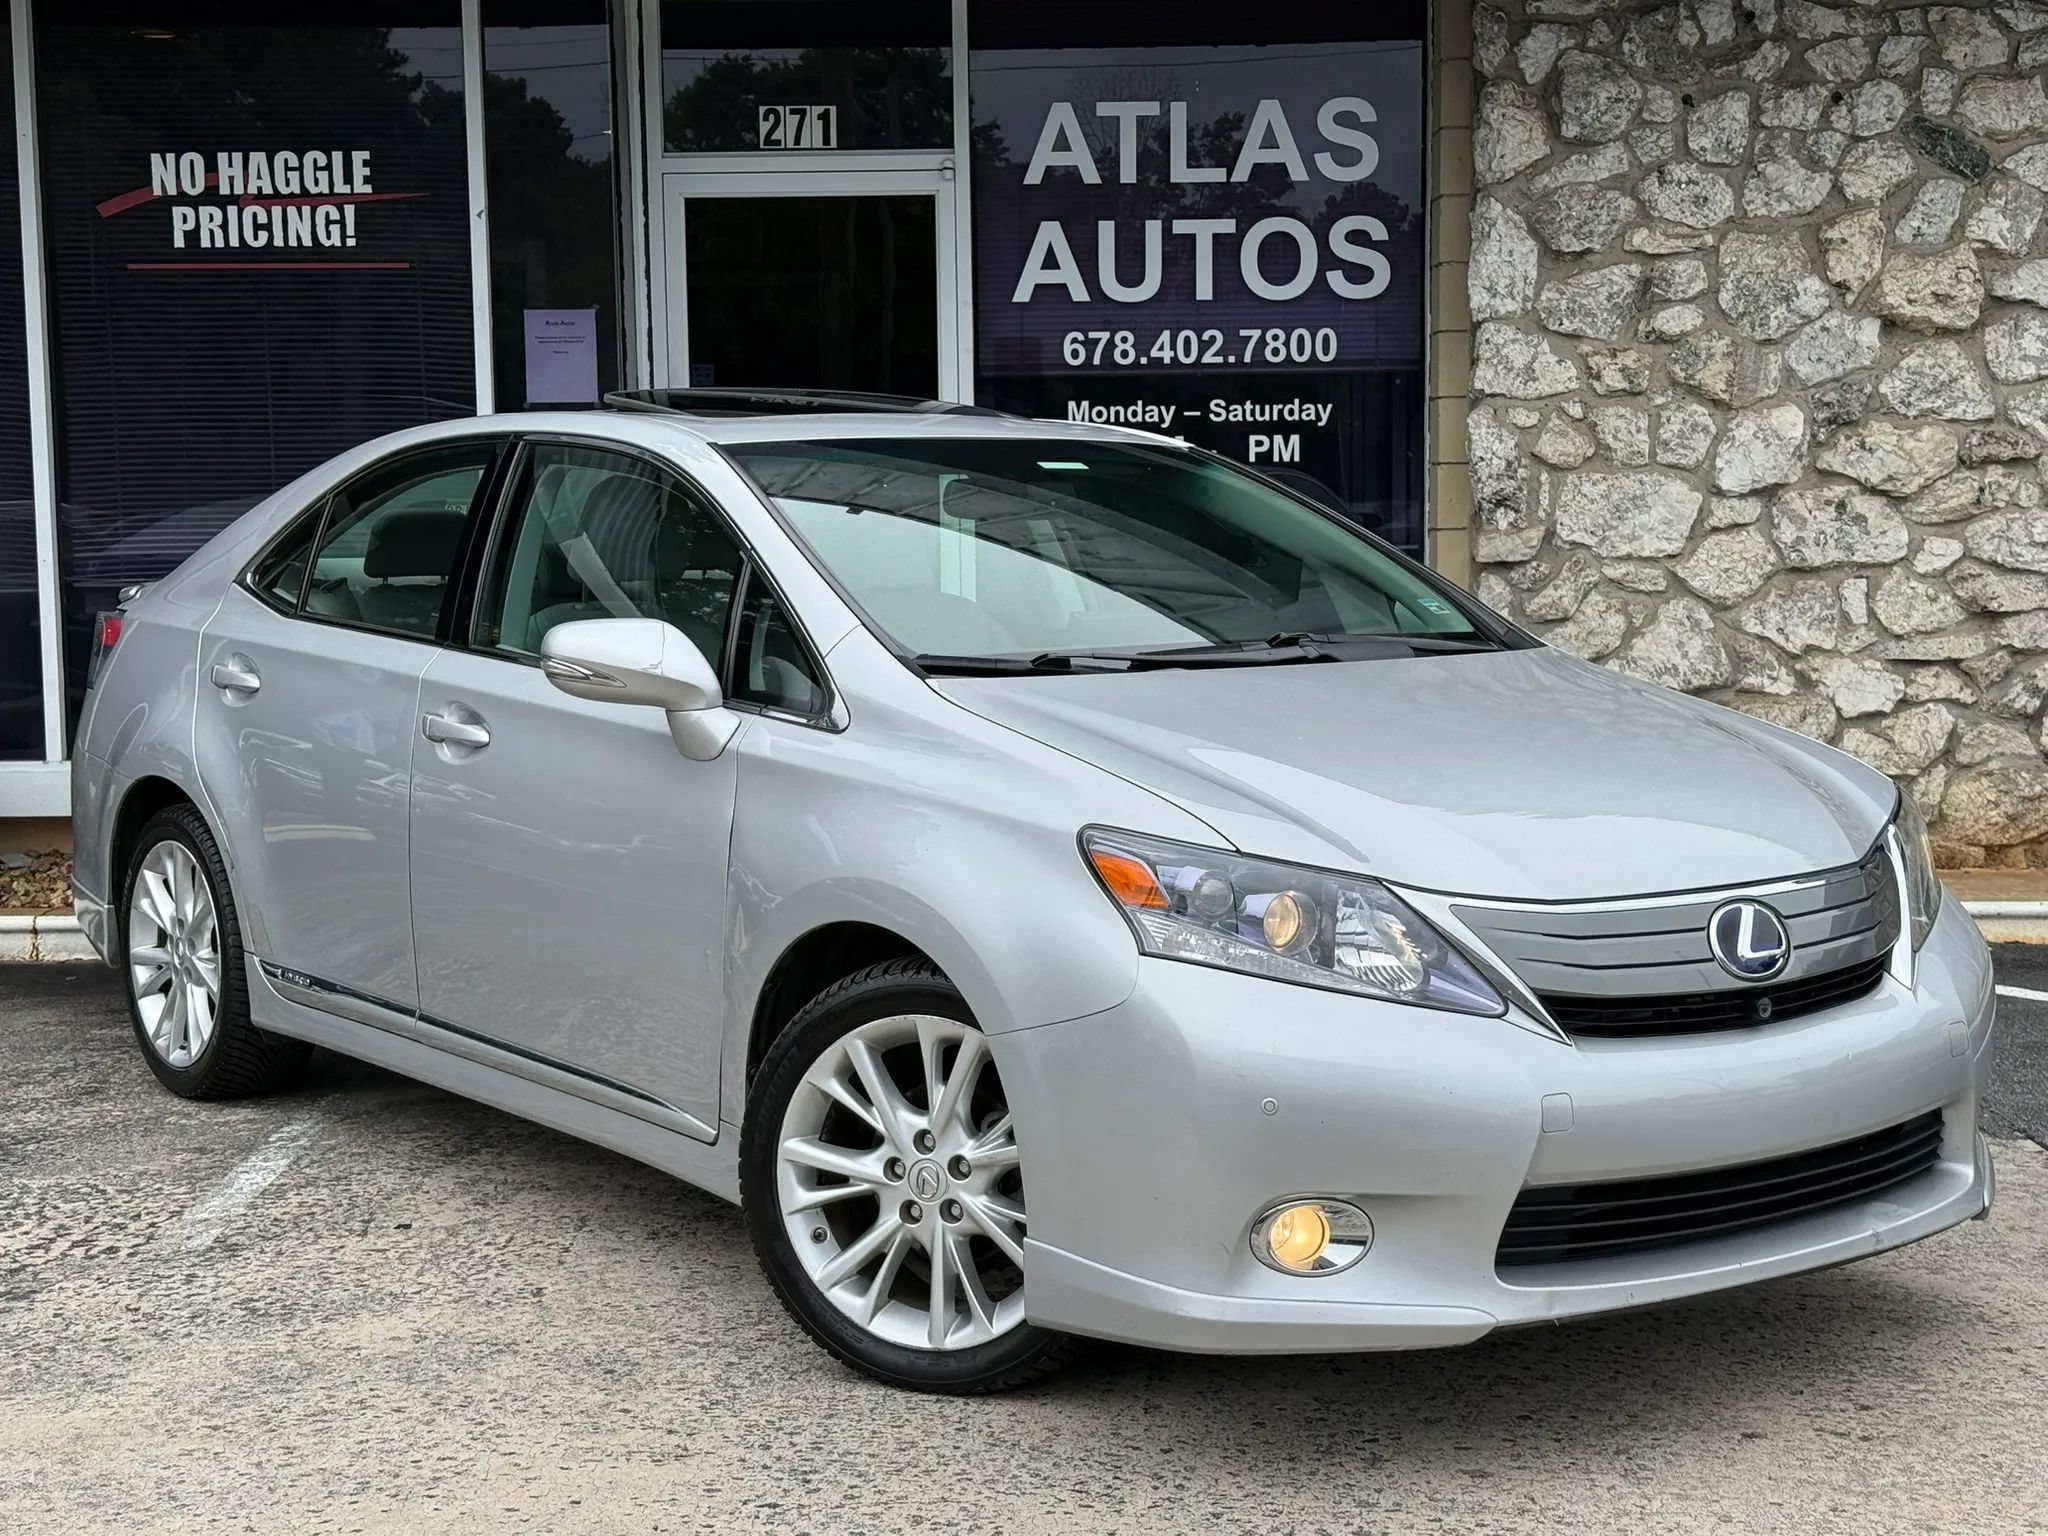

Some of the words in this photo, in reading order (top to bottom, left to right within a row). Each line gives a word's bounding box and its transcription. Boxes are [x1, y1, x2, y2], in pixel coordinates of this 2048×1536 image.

[762, 107, 831, 147] 271
[1023, 97, 1380, 185] ATLAS
[150, 151, 206, 196] NO
[217, 150, 373, 195] HAGGLE
[171, 204, 357, 249] PRICING!
[1012, 215, 1392, 303] AUTOS
[1063, 327, 1338, 366] 678.402.7800
[1067, 400, 1176, 428] Monday
[1208, 398, 1333, 427] Saturday
[1248, 434, 1300, 462] PM
